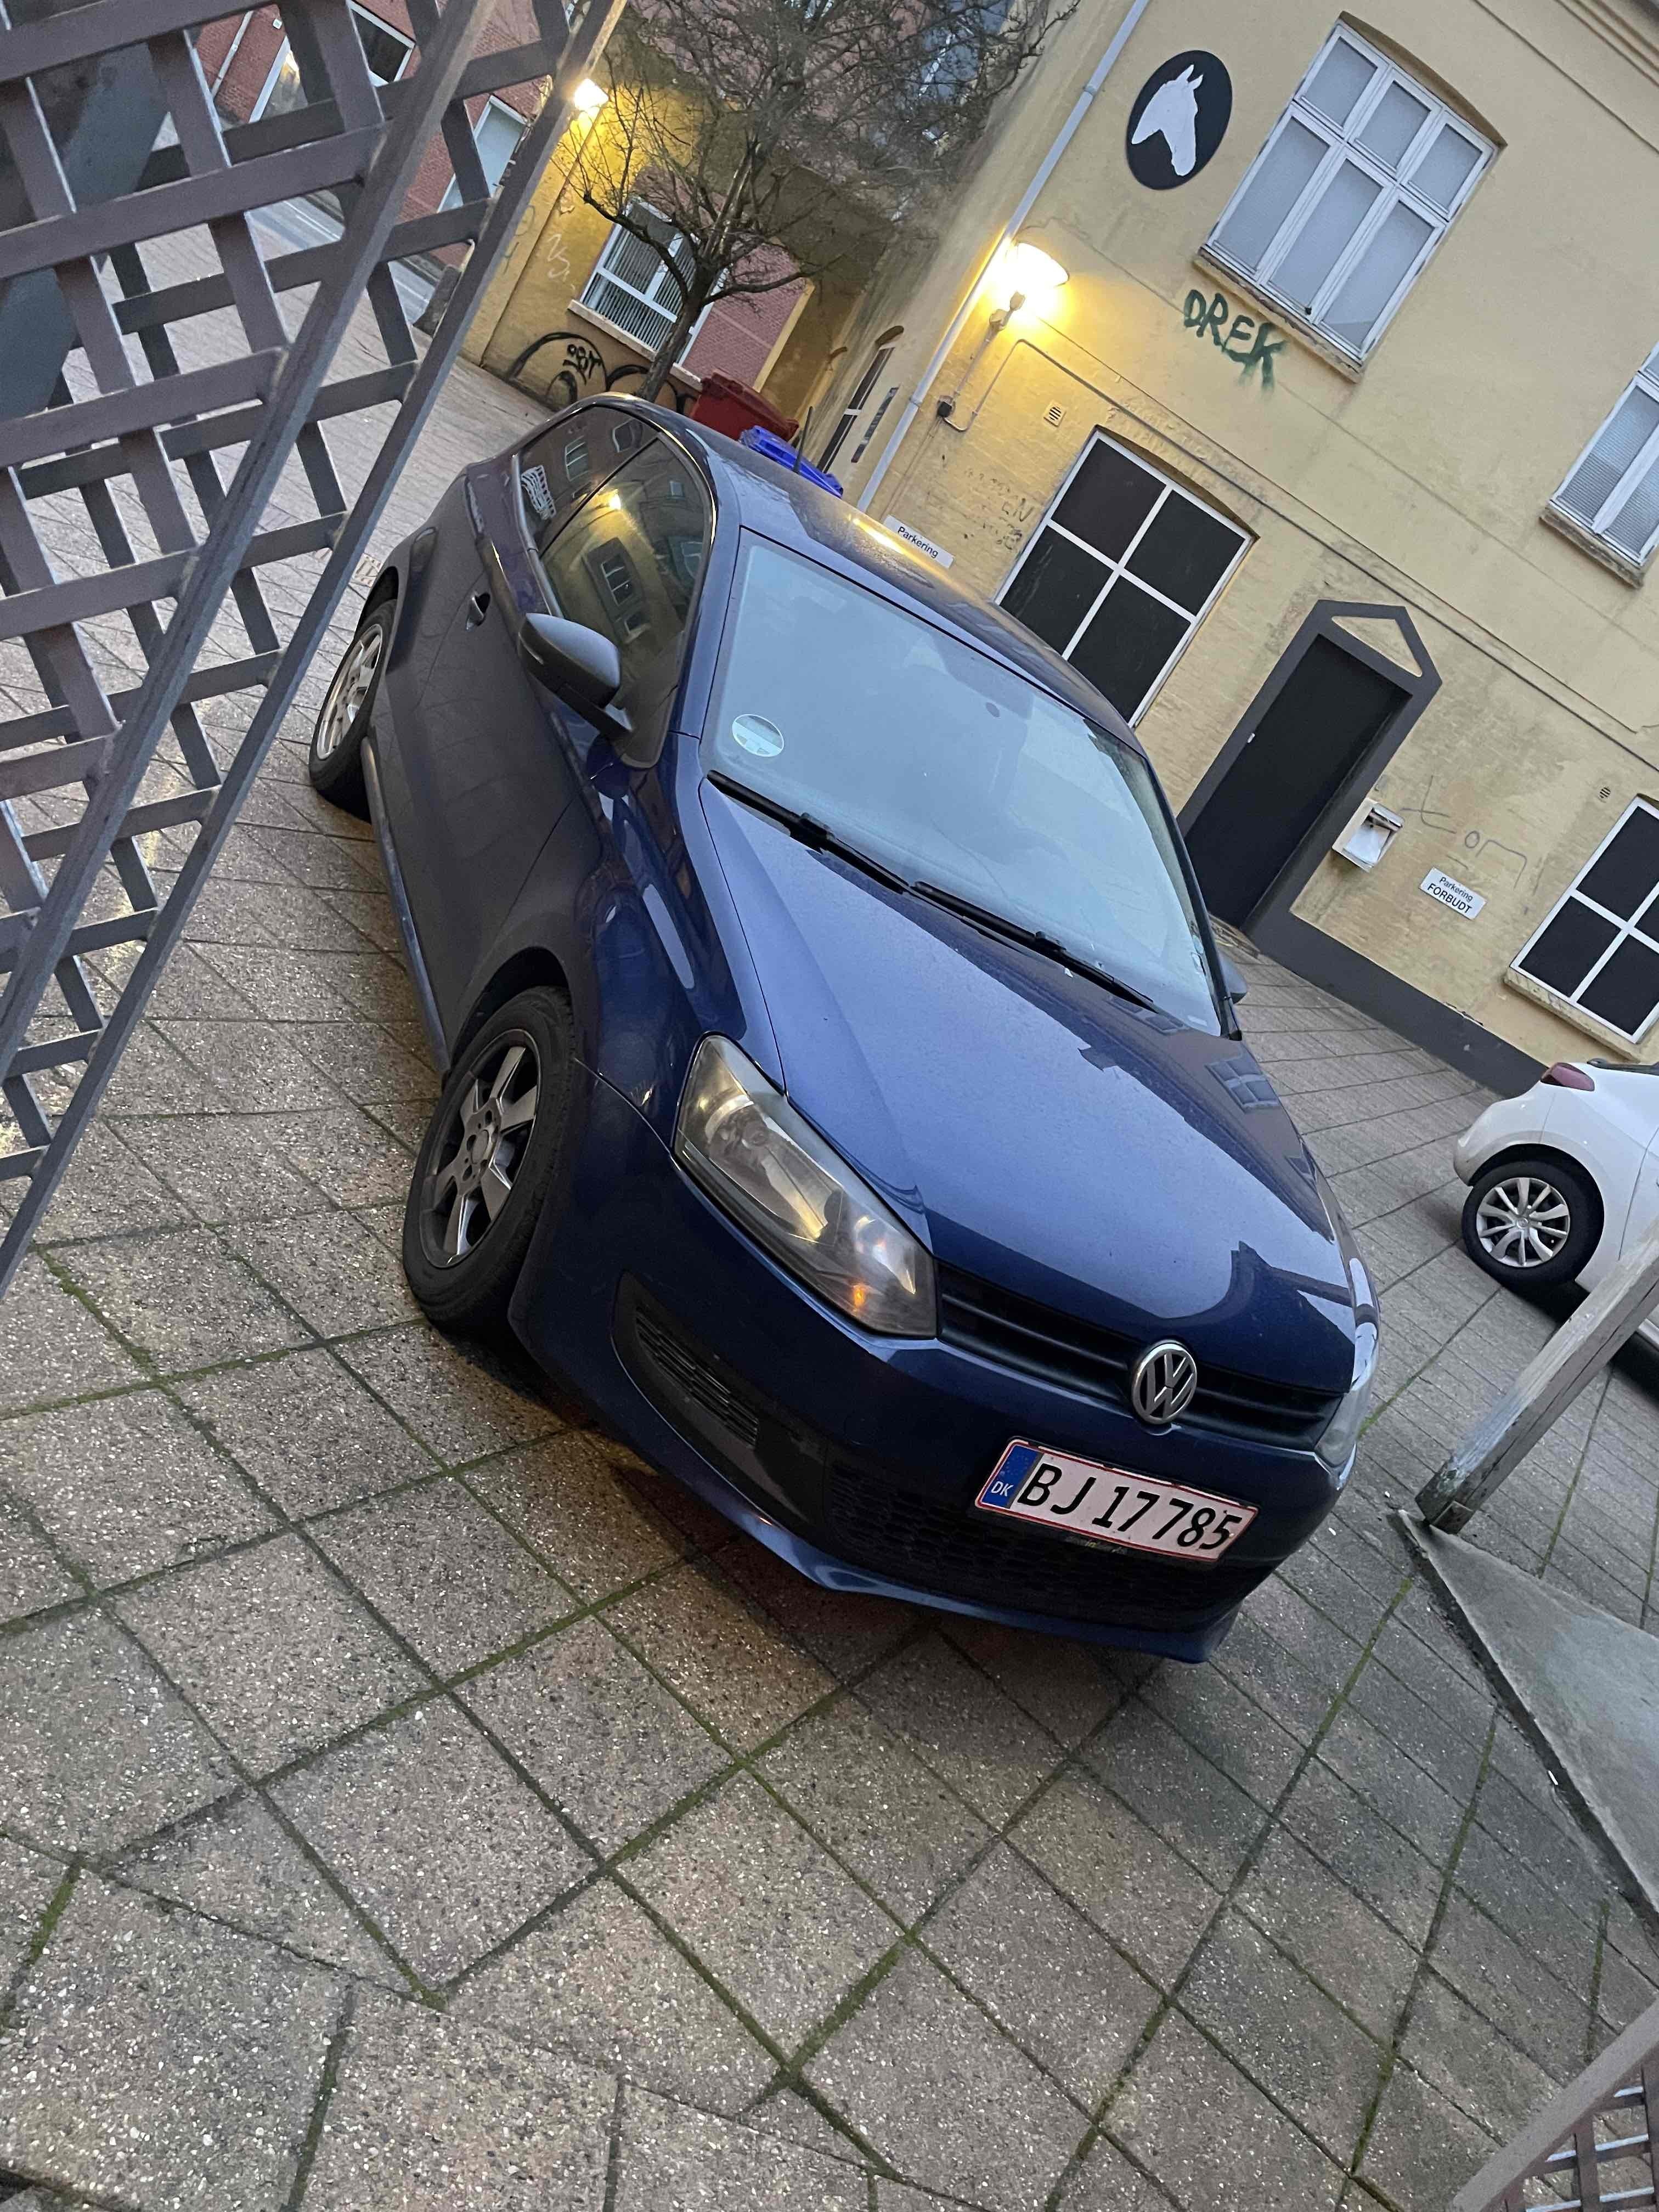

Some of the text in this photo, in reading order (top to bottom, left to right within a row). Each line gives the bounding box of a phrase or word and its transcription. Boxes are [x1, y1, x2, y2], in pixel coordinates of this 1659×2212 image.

[1184, 289, 1289, 390] DREK
[898, 526, 938, 558] Parkering
[1427, 883, 1472, 913] FORBUDT
[1440, 877, 1473, 902] Parkering
[991, 1481, 1014, 1497] DK
